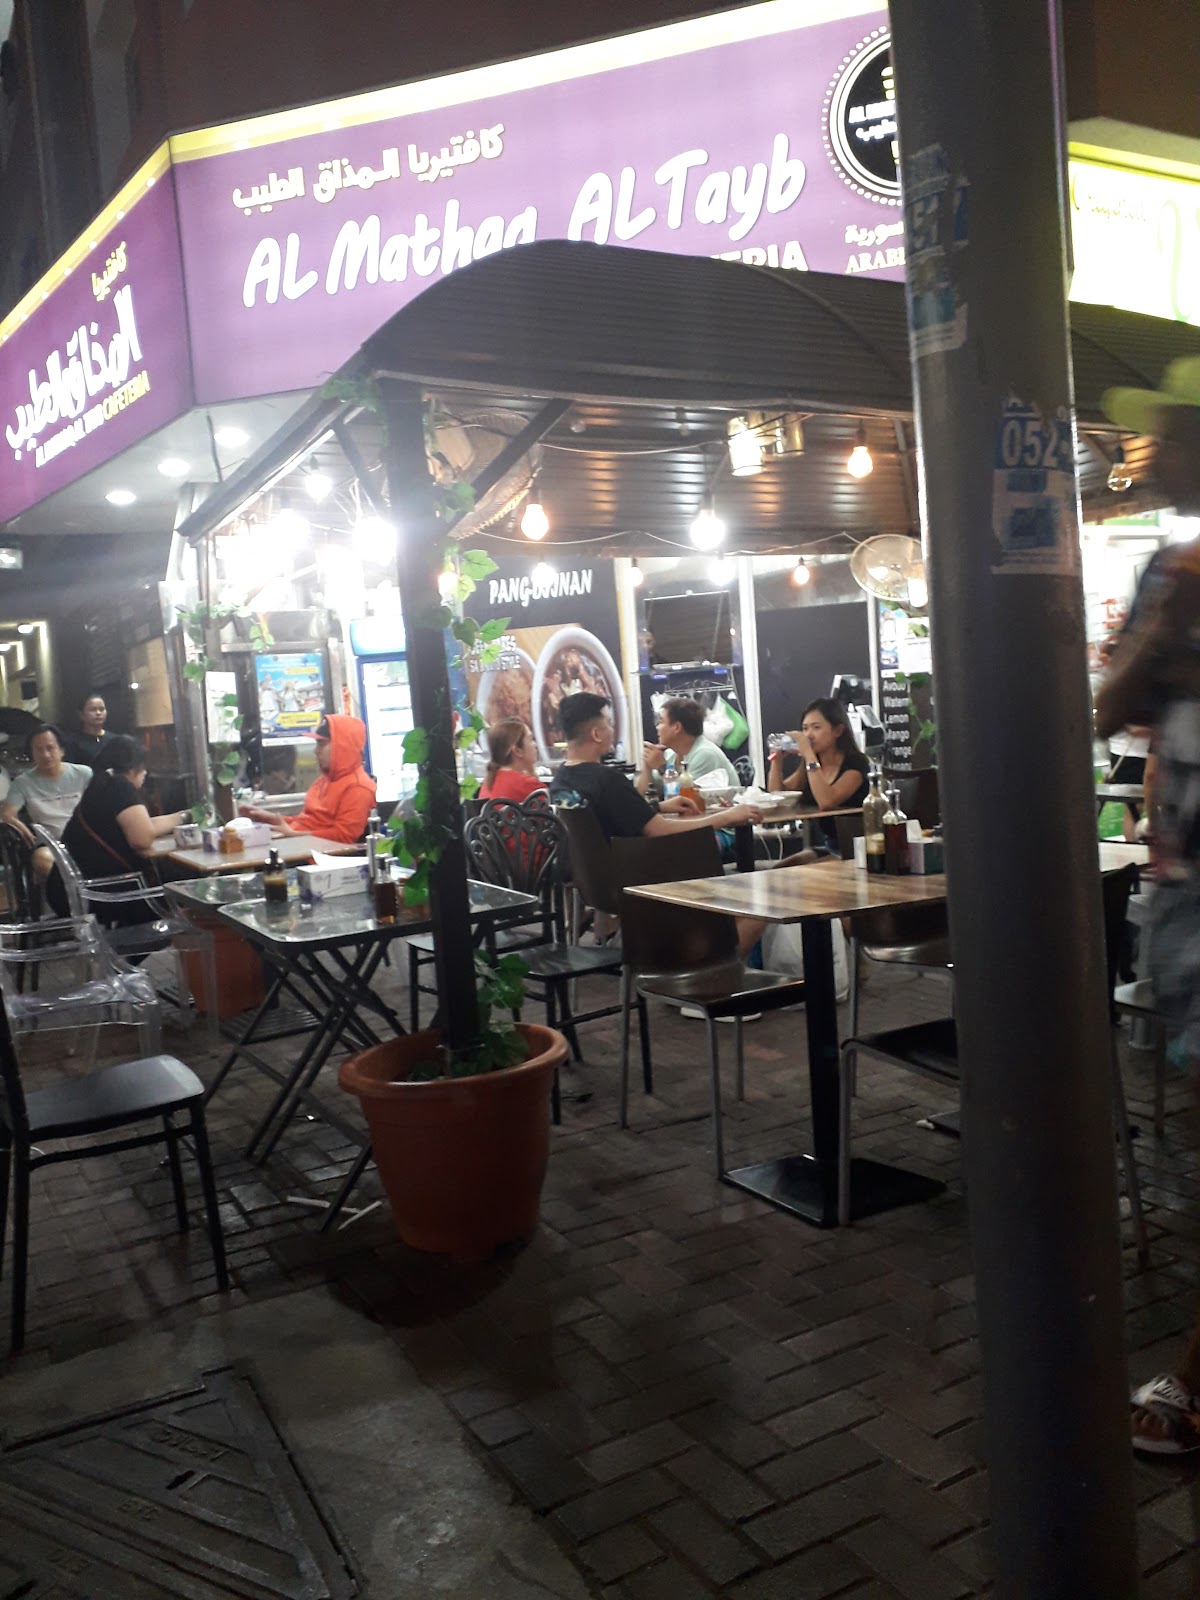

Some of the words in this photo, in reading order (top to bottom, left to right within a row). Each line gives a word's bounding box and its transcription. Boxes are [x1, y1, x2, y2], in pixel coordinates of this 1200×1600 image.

[407, 123, 505, 183] كافتيريا
[232, 166, 306, 216] الطيب
[242, 231, 319, 308] AL
[567, 166, 656, 245] AL
[654, 132, 807, 242] Tayb
